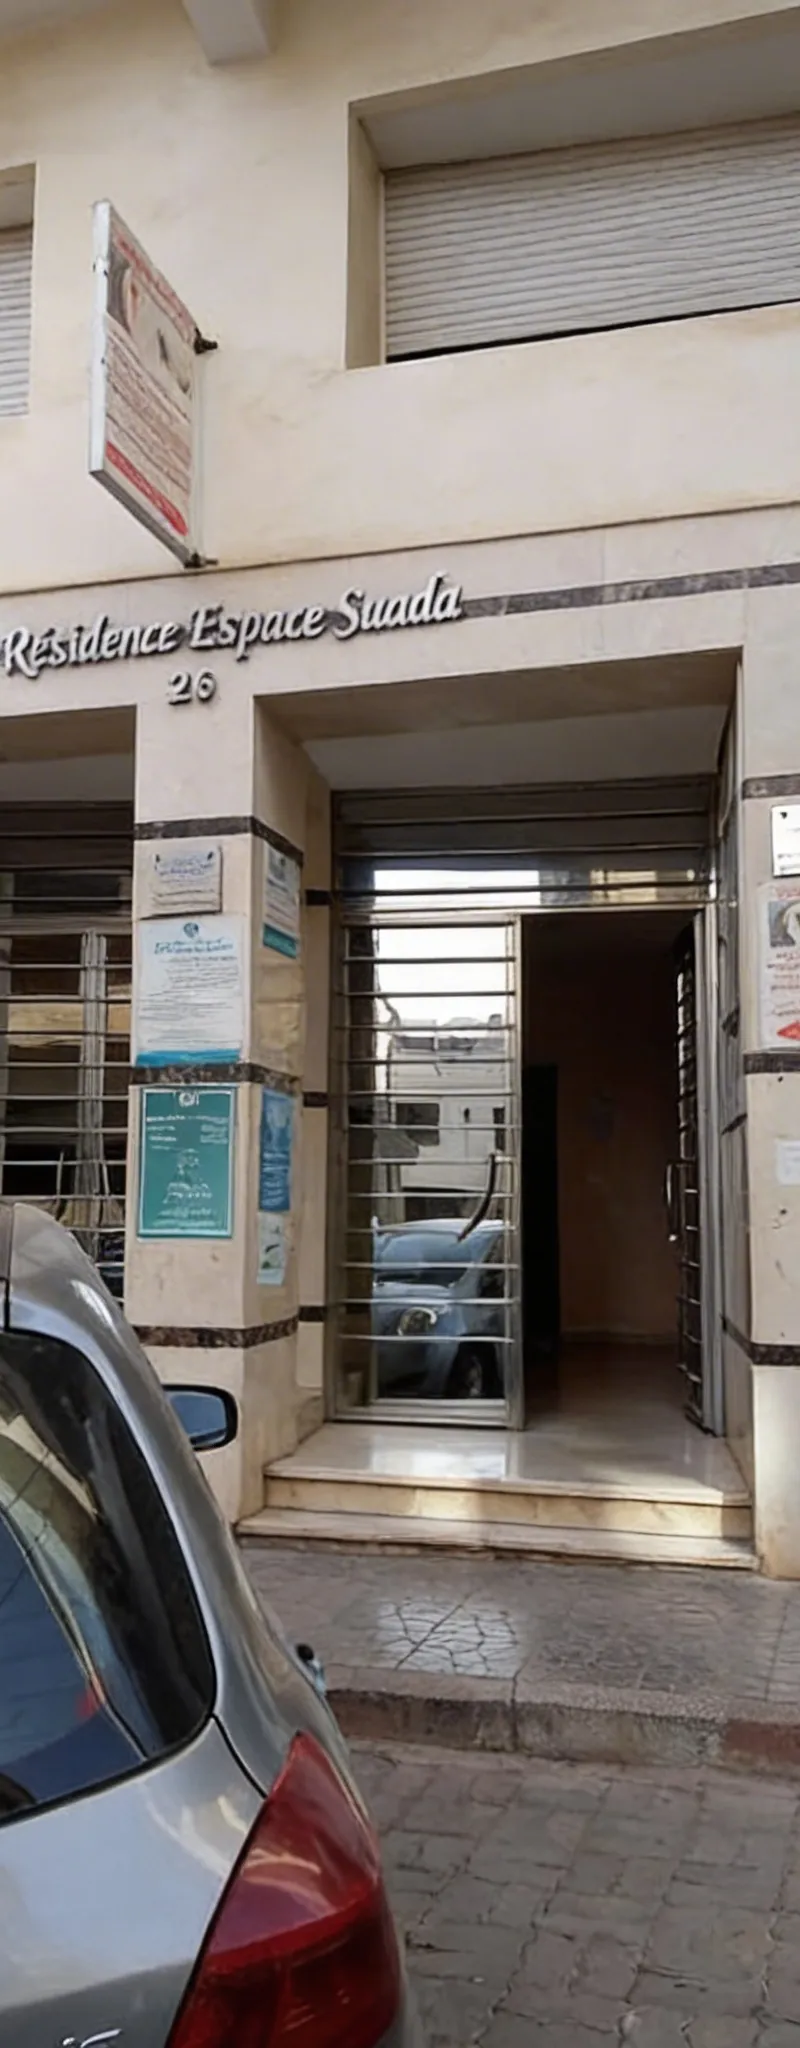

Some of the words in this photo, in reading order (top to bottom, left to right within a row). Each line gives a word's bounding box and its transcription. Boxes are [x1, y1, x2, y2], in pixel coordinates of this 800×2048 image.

[3, 614, 179, 678] Résidence
[190, 602, 326, 662] Espace
[332, 570, 462, 639] Suada
[168, 668, 216, 704] 26
